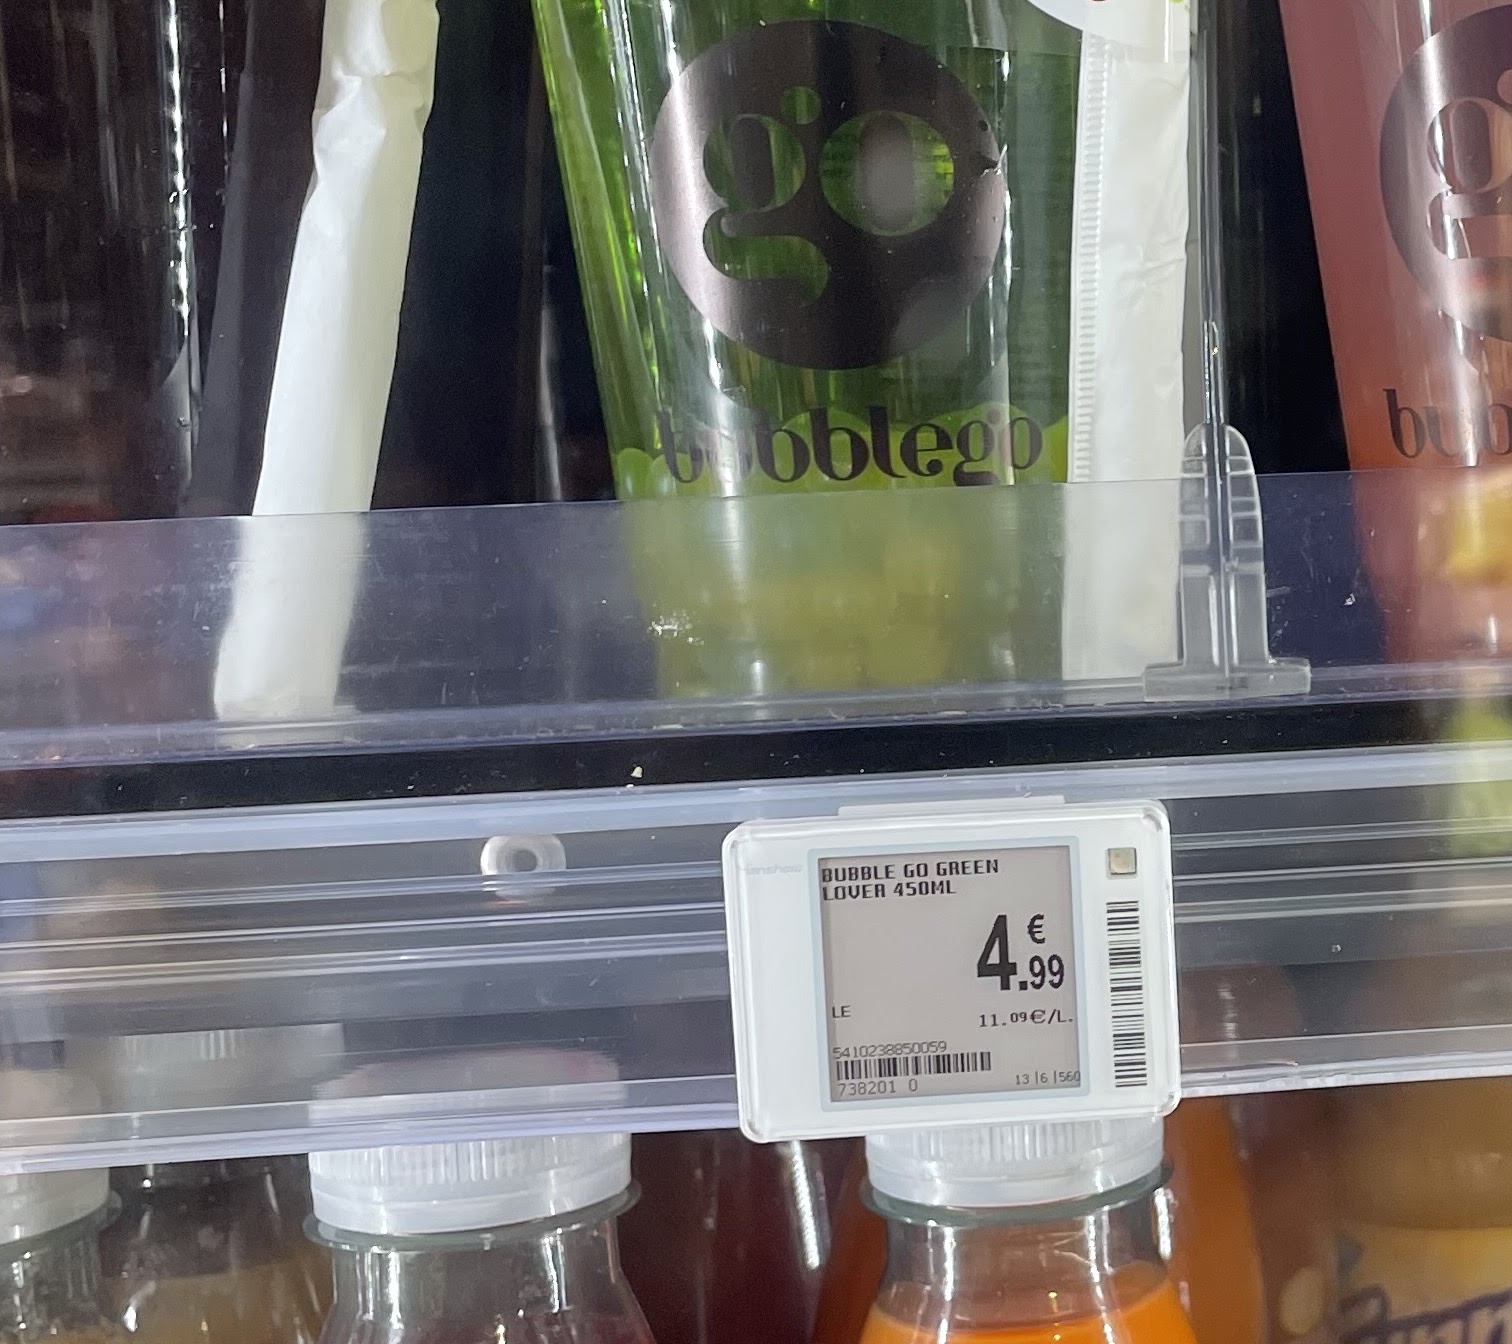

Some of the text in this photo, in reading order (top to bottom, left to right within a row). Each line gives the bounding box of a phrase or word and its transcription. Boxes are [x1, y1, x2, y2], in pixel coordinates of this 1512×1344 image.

[821, 858, 999, 884] BUBBLE GO GREEN
[822, 880, 957, 902] LOVER 450ML
[831, 1005, 851, 1019] LE
[832, 1041, 948, 1060] 5410238850059
[838, 1078, 919, 1096] 738201 0
[1014, 1074, 1030, 1086] 13
